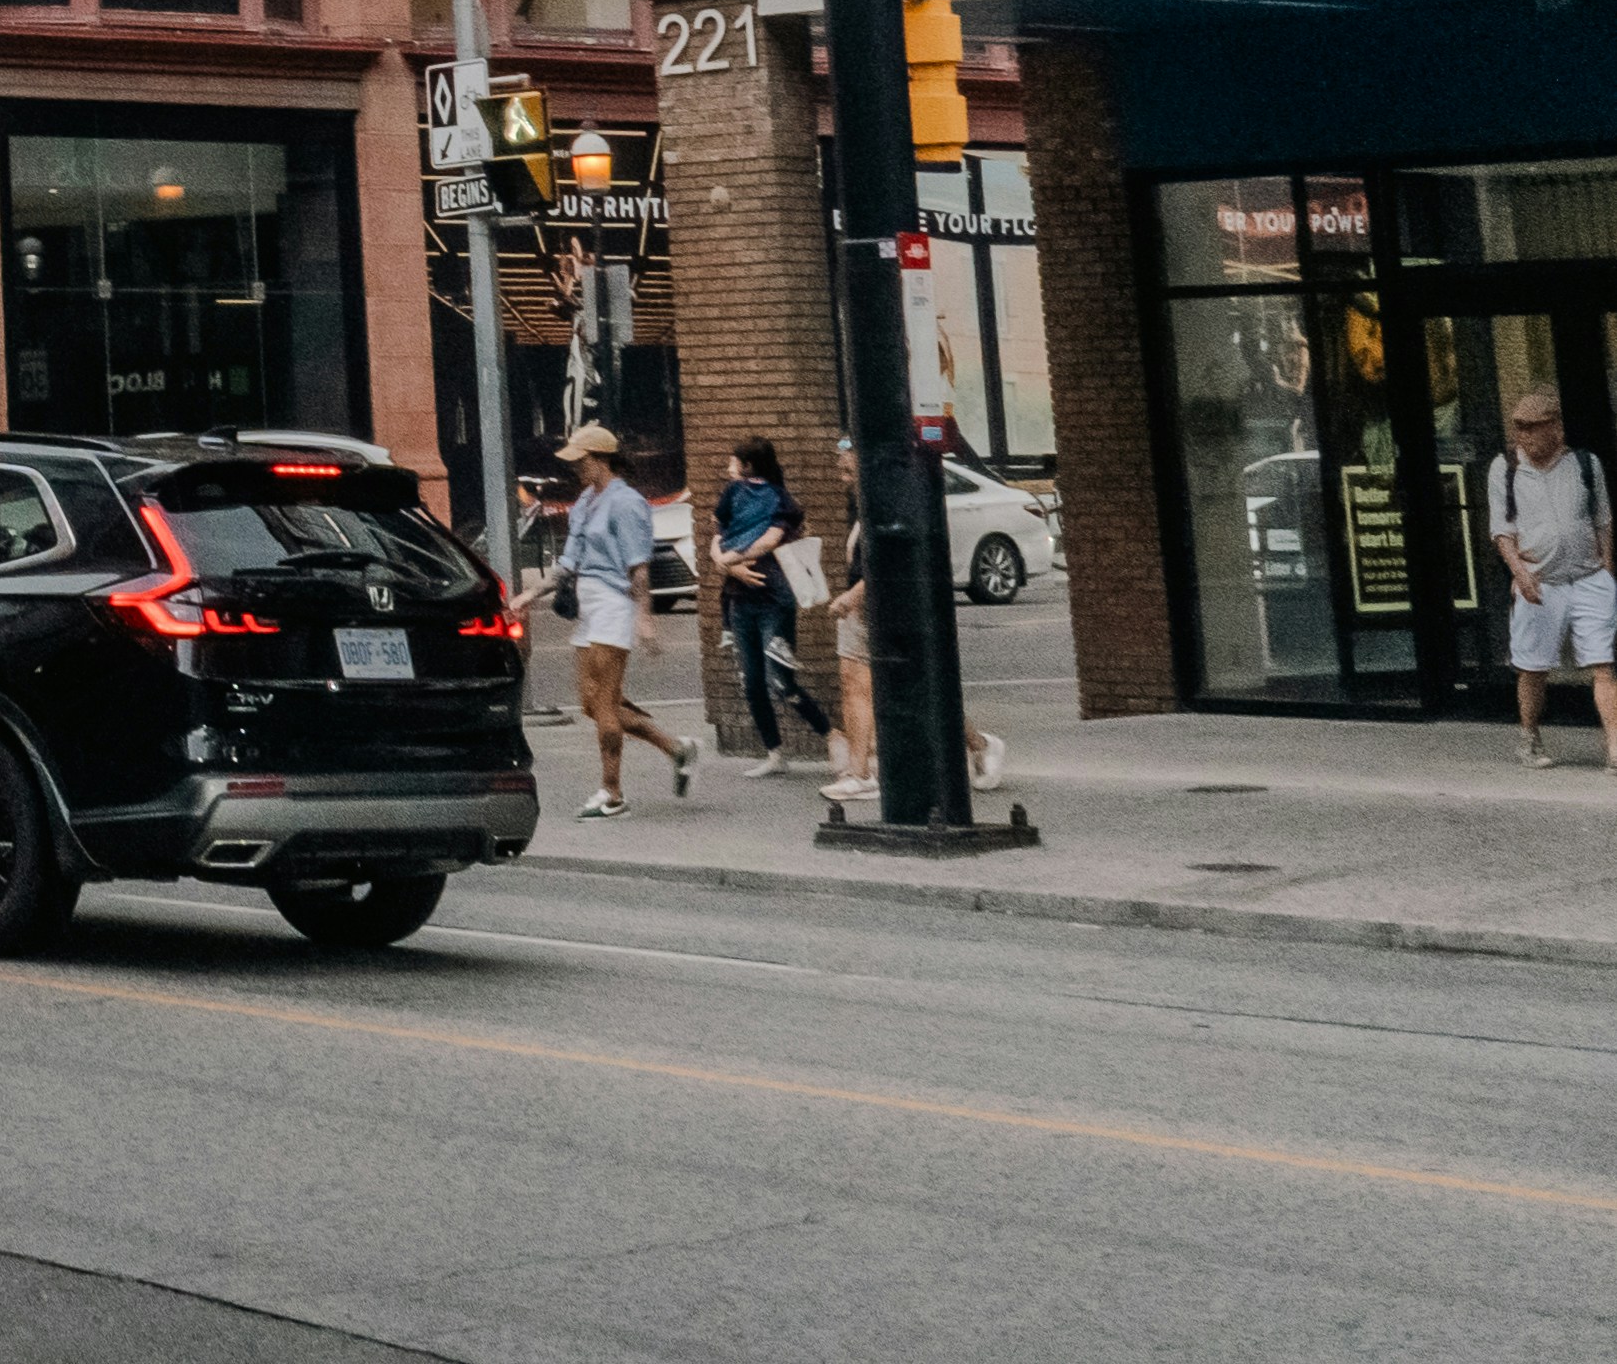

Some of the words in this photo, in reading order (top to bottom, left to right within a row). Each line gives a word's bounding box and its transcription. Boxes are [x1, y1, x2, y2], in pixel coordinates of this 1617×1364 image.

[657, 4, 759, 76] 221
[459, 145, 484, 159] LANE
[440, 179, 490, 211] BEGINS
[933, 212, 994, 235] YOUR
[1001, 218, 1038, 236] FLO
[1251, 211, 1296, 233] YOU
[1311, 212, 1367, 235] POWE
